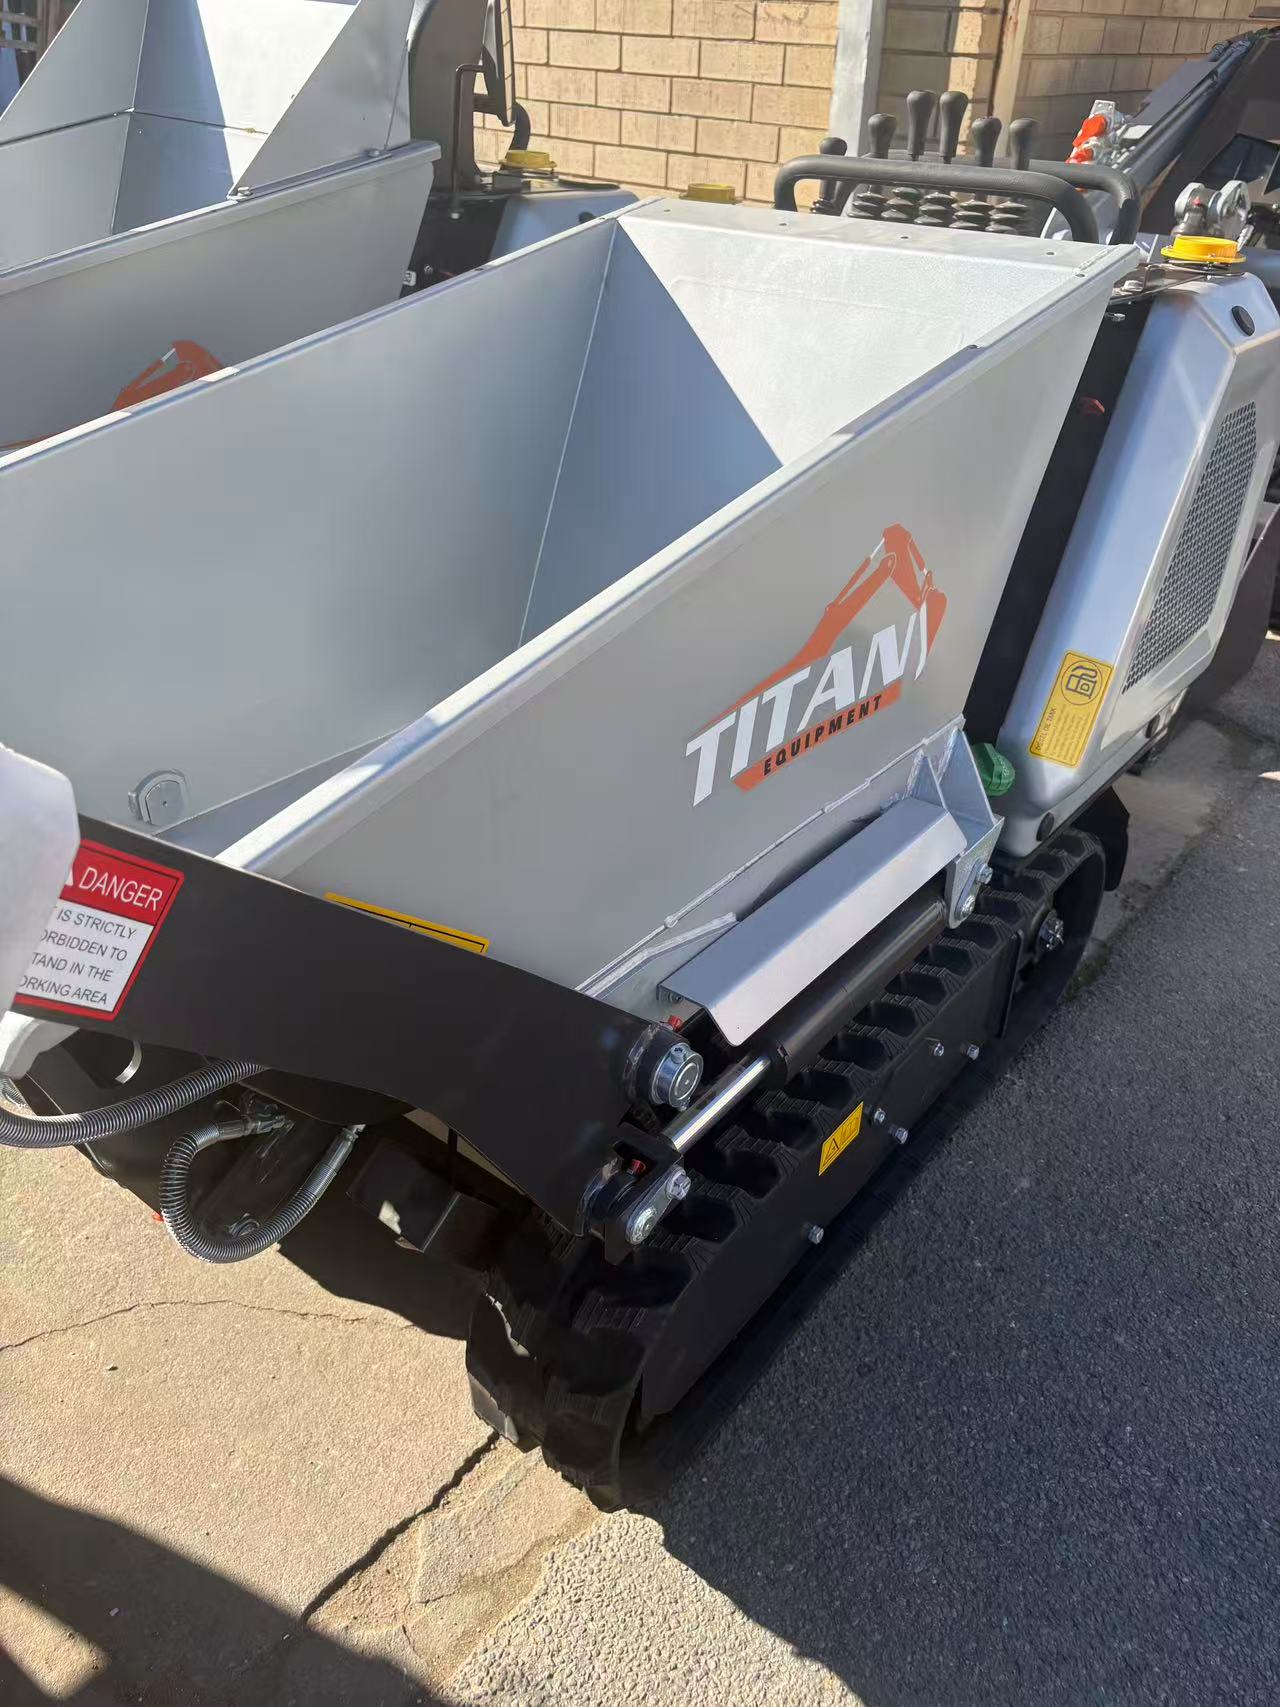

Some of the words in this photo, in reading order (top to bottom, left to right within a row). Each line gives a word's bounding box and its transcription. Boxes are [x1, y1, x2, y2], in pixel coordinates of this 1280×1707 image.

[686, 611, 918, 807] TITAN
[763, 694, 882, 777] EQUIPMENT
[79, 867, 163, 911] DANGER
[57, 908, 72, 922] IS
[73, 913, 137, 940] STRICTLY
[40, 929, 108, 957] RBIDDEN
[109, 948, 128, 961] TO
[31, 951, 68, 971] TAND
[69, 962, 85, 975] IN
[87, 965, 114, 982] THE
[19, 974, 72, 997] ORKING
[71, 987, 107, 1005] AREA
